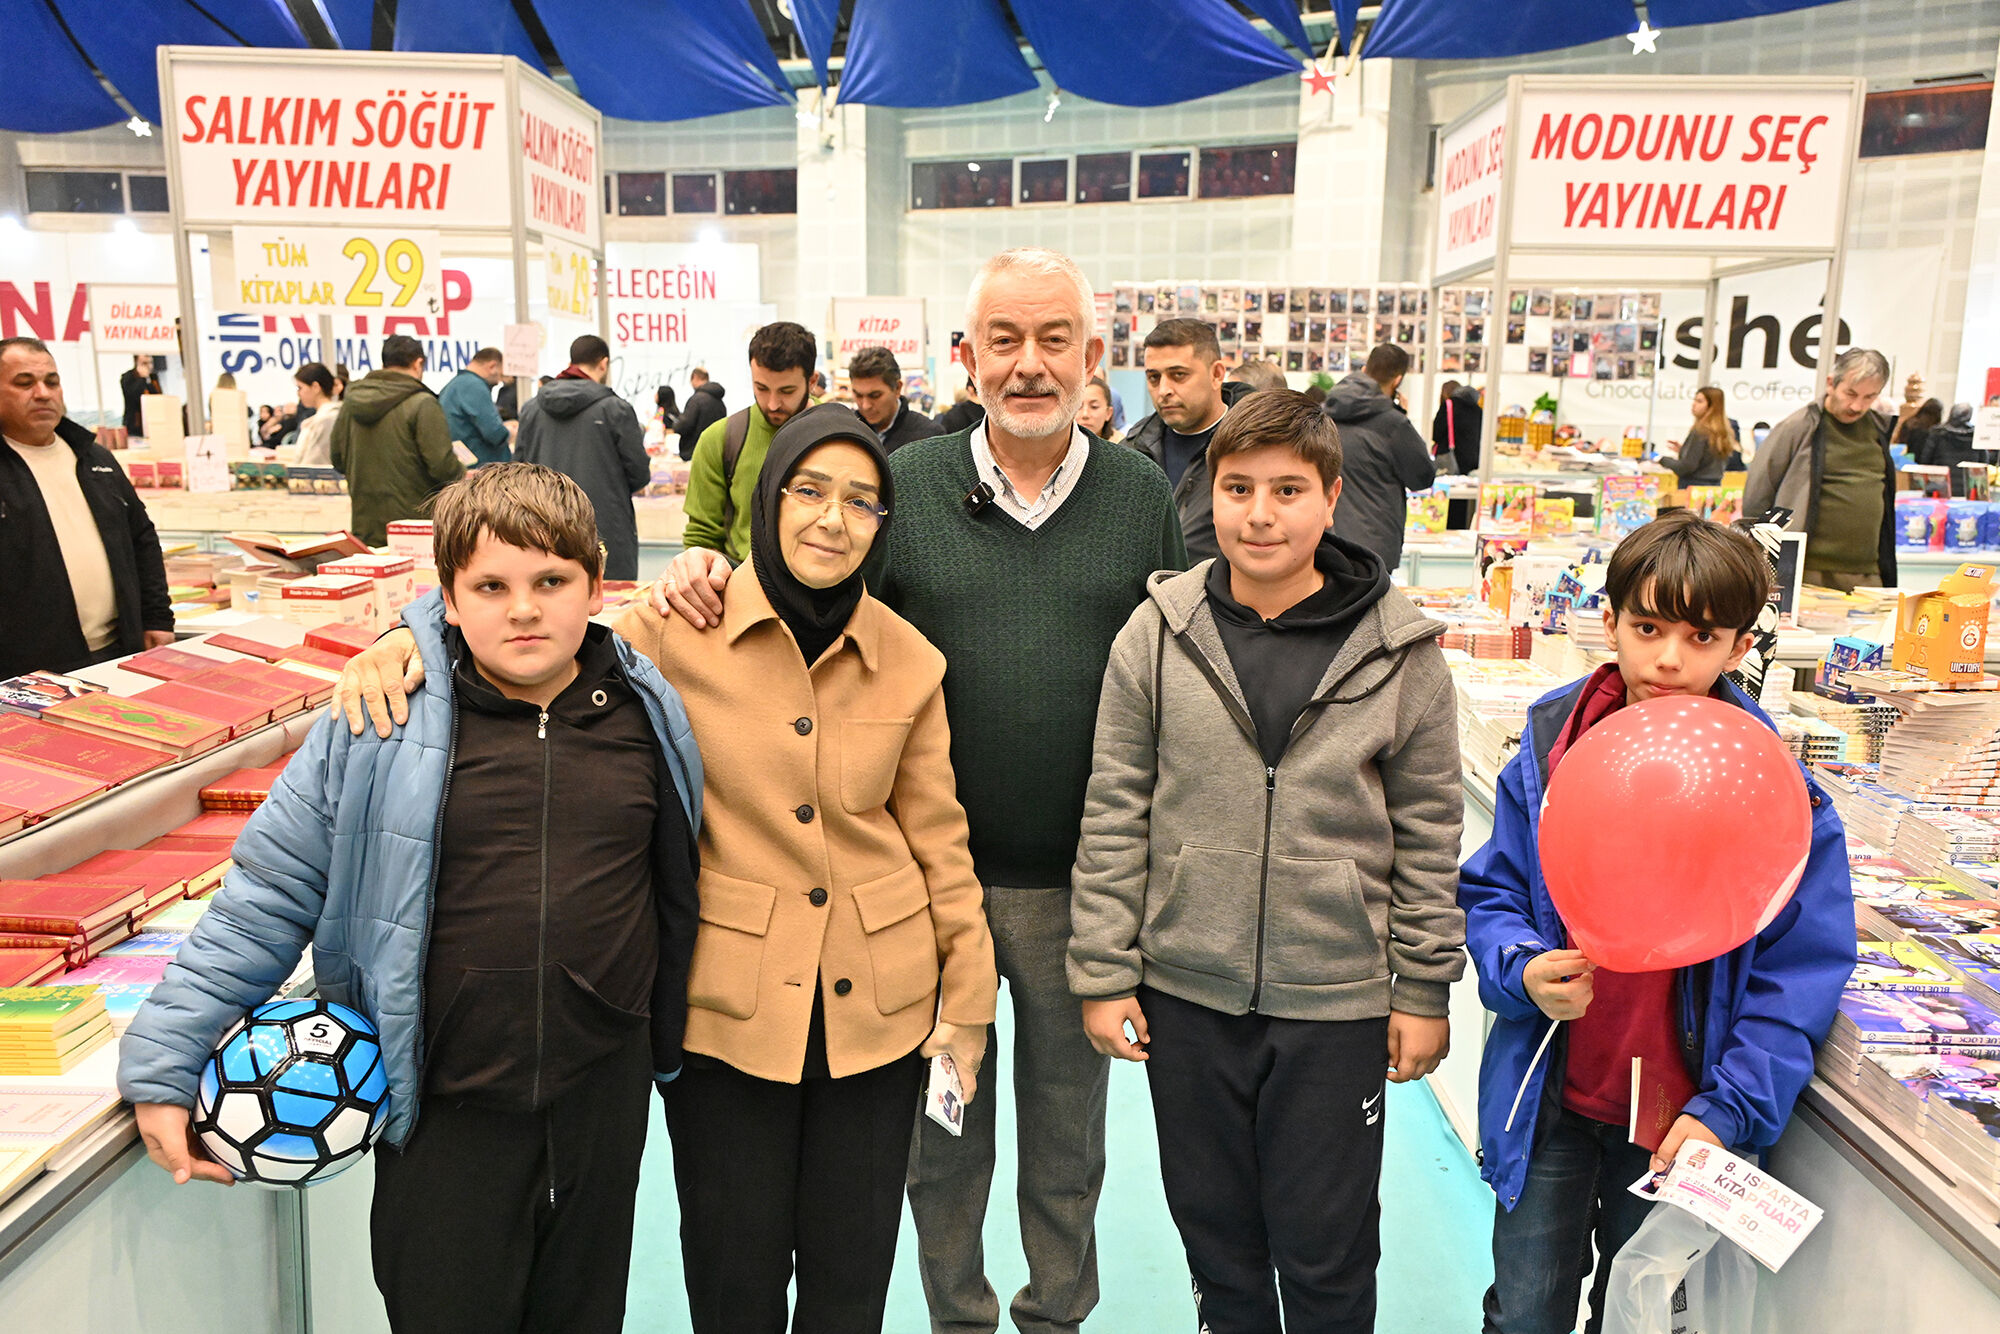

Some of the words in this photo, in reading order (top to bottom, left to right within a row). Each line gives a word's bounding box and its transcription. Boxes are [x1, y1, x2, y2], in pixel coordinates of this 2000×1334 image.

[182, 95, 339, 146] SALKIM
[352, 91, 495, 149] SÖĞÜT
[520, 110, 559, 170] ALKIM
[1530, 112, 1734, 162] MODUNU
[1741, 115, 1829, 175] SEÇ
[233, 159, 451, 210] YAYINLARI
[531, 173, 586, 234] YAYINLARI
[1563, 182, 1787, 231] YAYINLARI
[262, 237, 308, 267] TÜM
[342, 237, 424, 307] 29
[241, 274, 336, 305] KİTAPLAR
[596, 264, 716, 299] LECEĞİN
[111, 301, 162, 319] DİLARA
[617, 307, 687, 347] ŞEHRİ
[858, 314, 900, 333] KİTAP
[104, 326, 175, 340] YAYINLARI
[1659, 293, 1851, 369] shé
[1732, 380, 1813, 400] Coffee
[310, 1023, 329, 1038] 5
[1725, 1162, 1736, 1175] 8.
[1743, 1172, 1810, 1221] ISPARTA
[1737, 1213, 1759, 1232] 50
